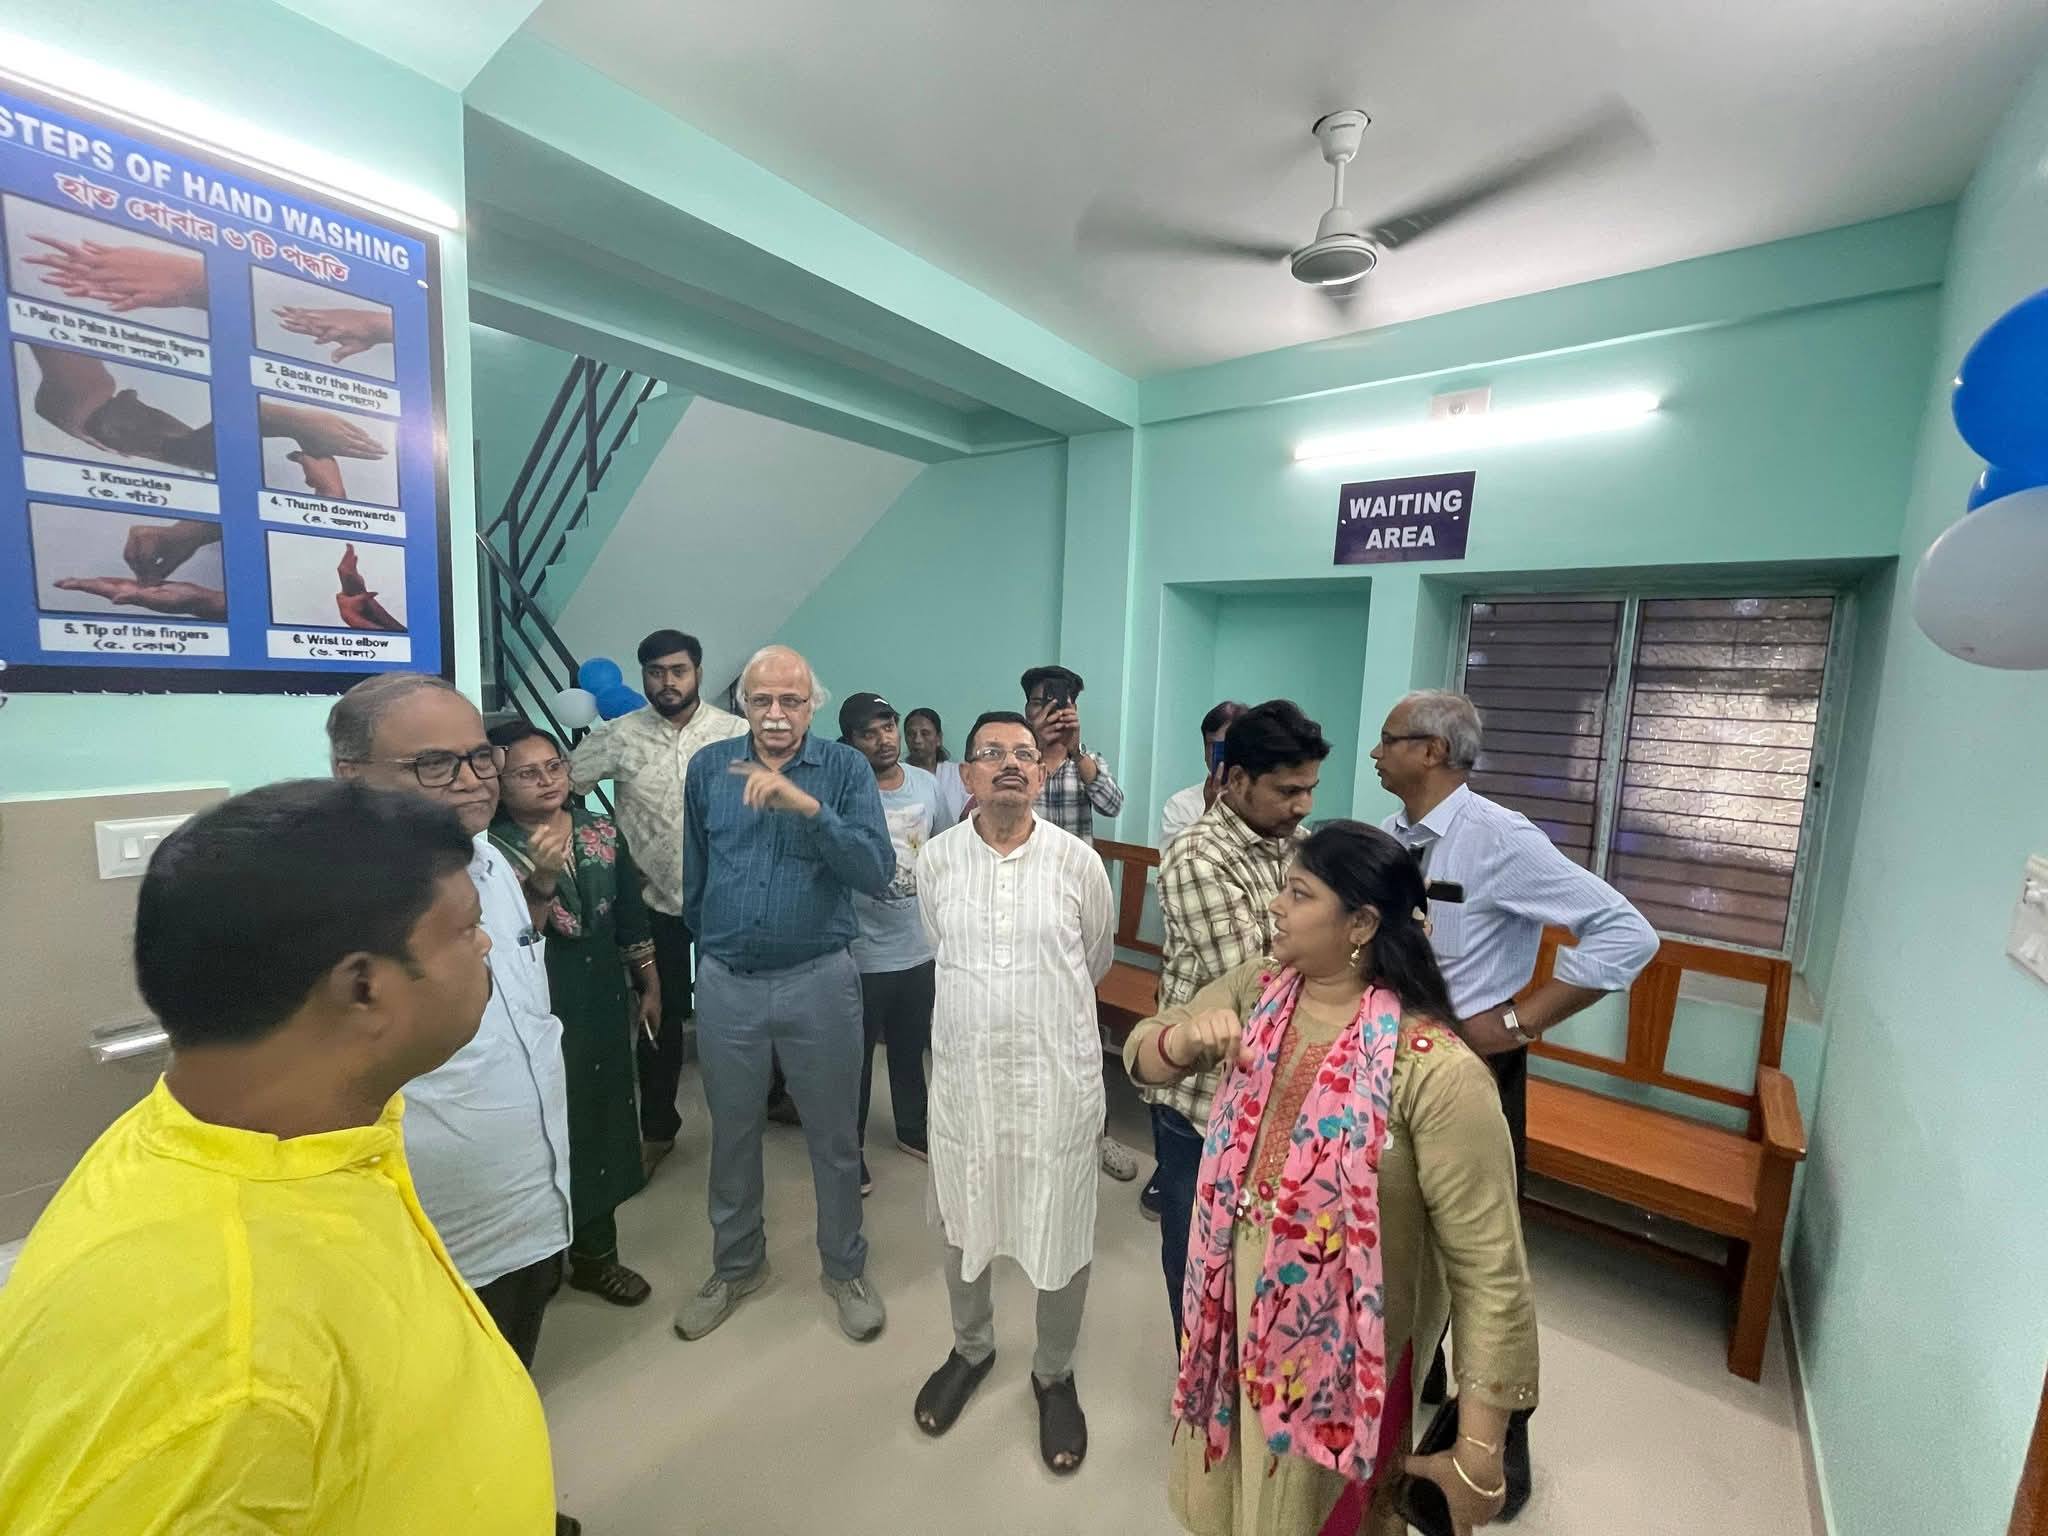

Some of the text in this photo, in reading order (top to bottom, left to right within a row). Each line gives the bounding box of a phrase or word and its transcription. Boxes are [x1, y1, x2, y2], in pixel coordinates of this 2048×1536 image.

[0, 105, 409, 270] STEPS OF HAND WASHING
[54, 173, 119, 209] হাত
[15, 303, 28, 317] 1.
[30, 306, 60, 323] Palm
[63, 313, 76, 328] to
[78, 318, 107, 335] Palm
[265, 362, 388, 399] 2. Back of the Hands
[81, 469, 172, 491] 3. Knuckles
[270, 496, 396, 522] 4. Thumb downwards
[1350, 489, 1462, 519] WAITING
[1365, 525, 1436, 550] AREA
[64, 623, 209, 641] 5. Tip of the fingers
[293, 633, 389, 648] 6. Wrist to elbow
